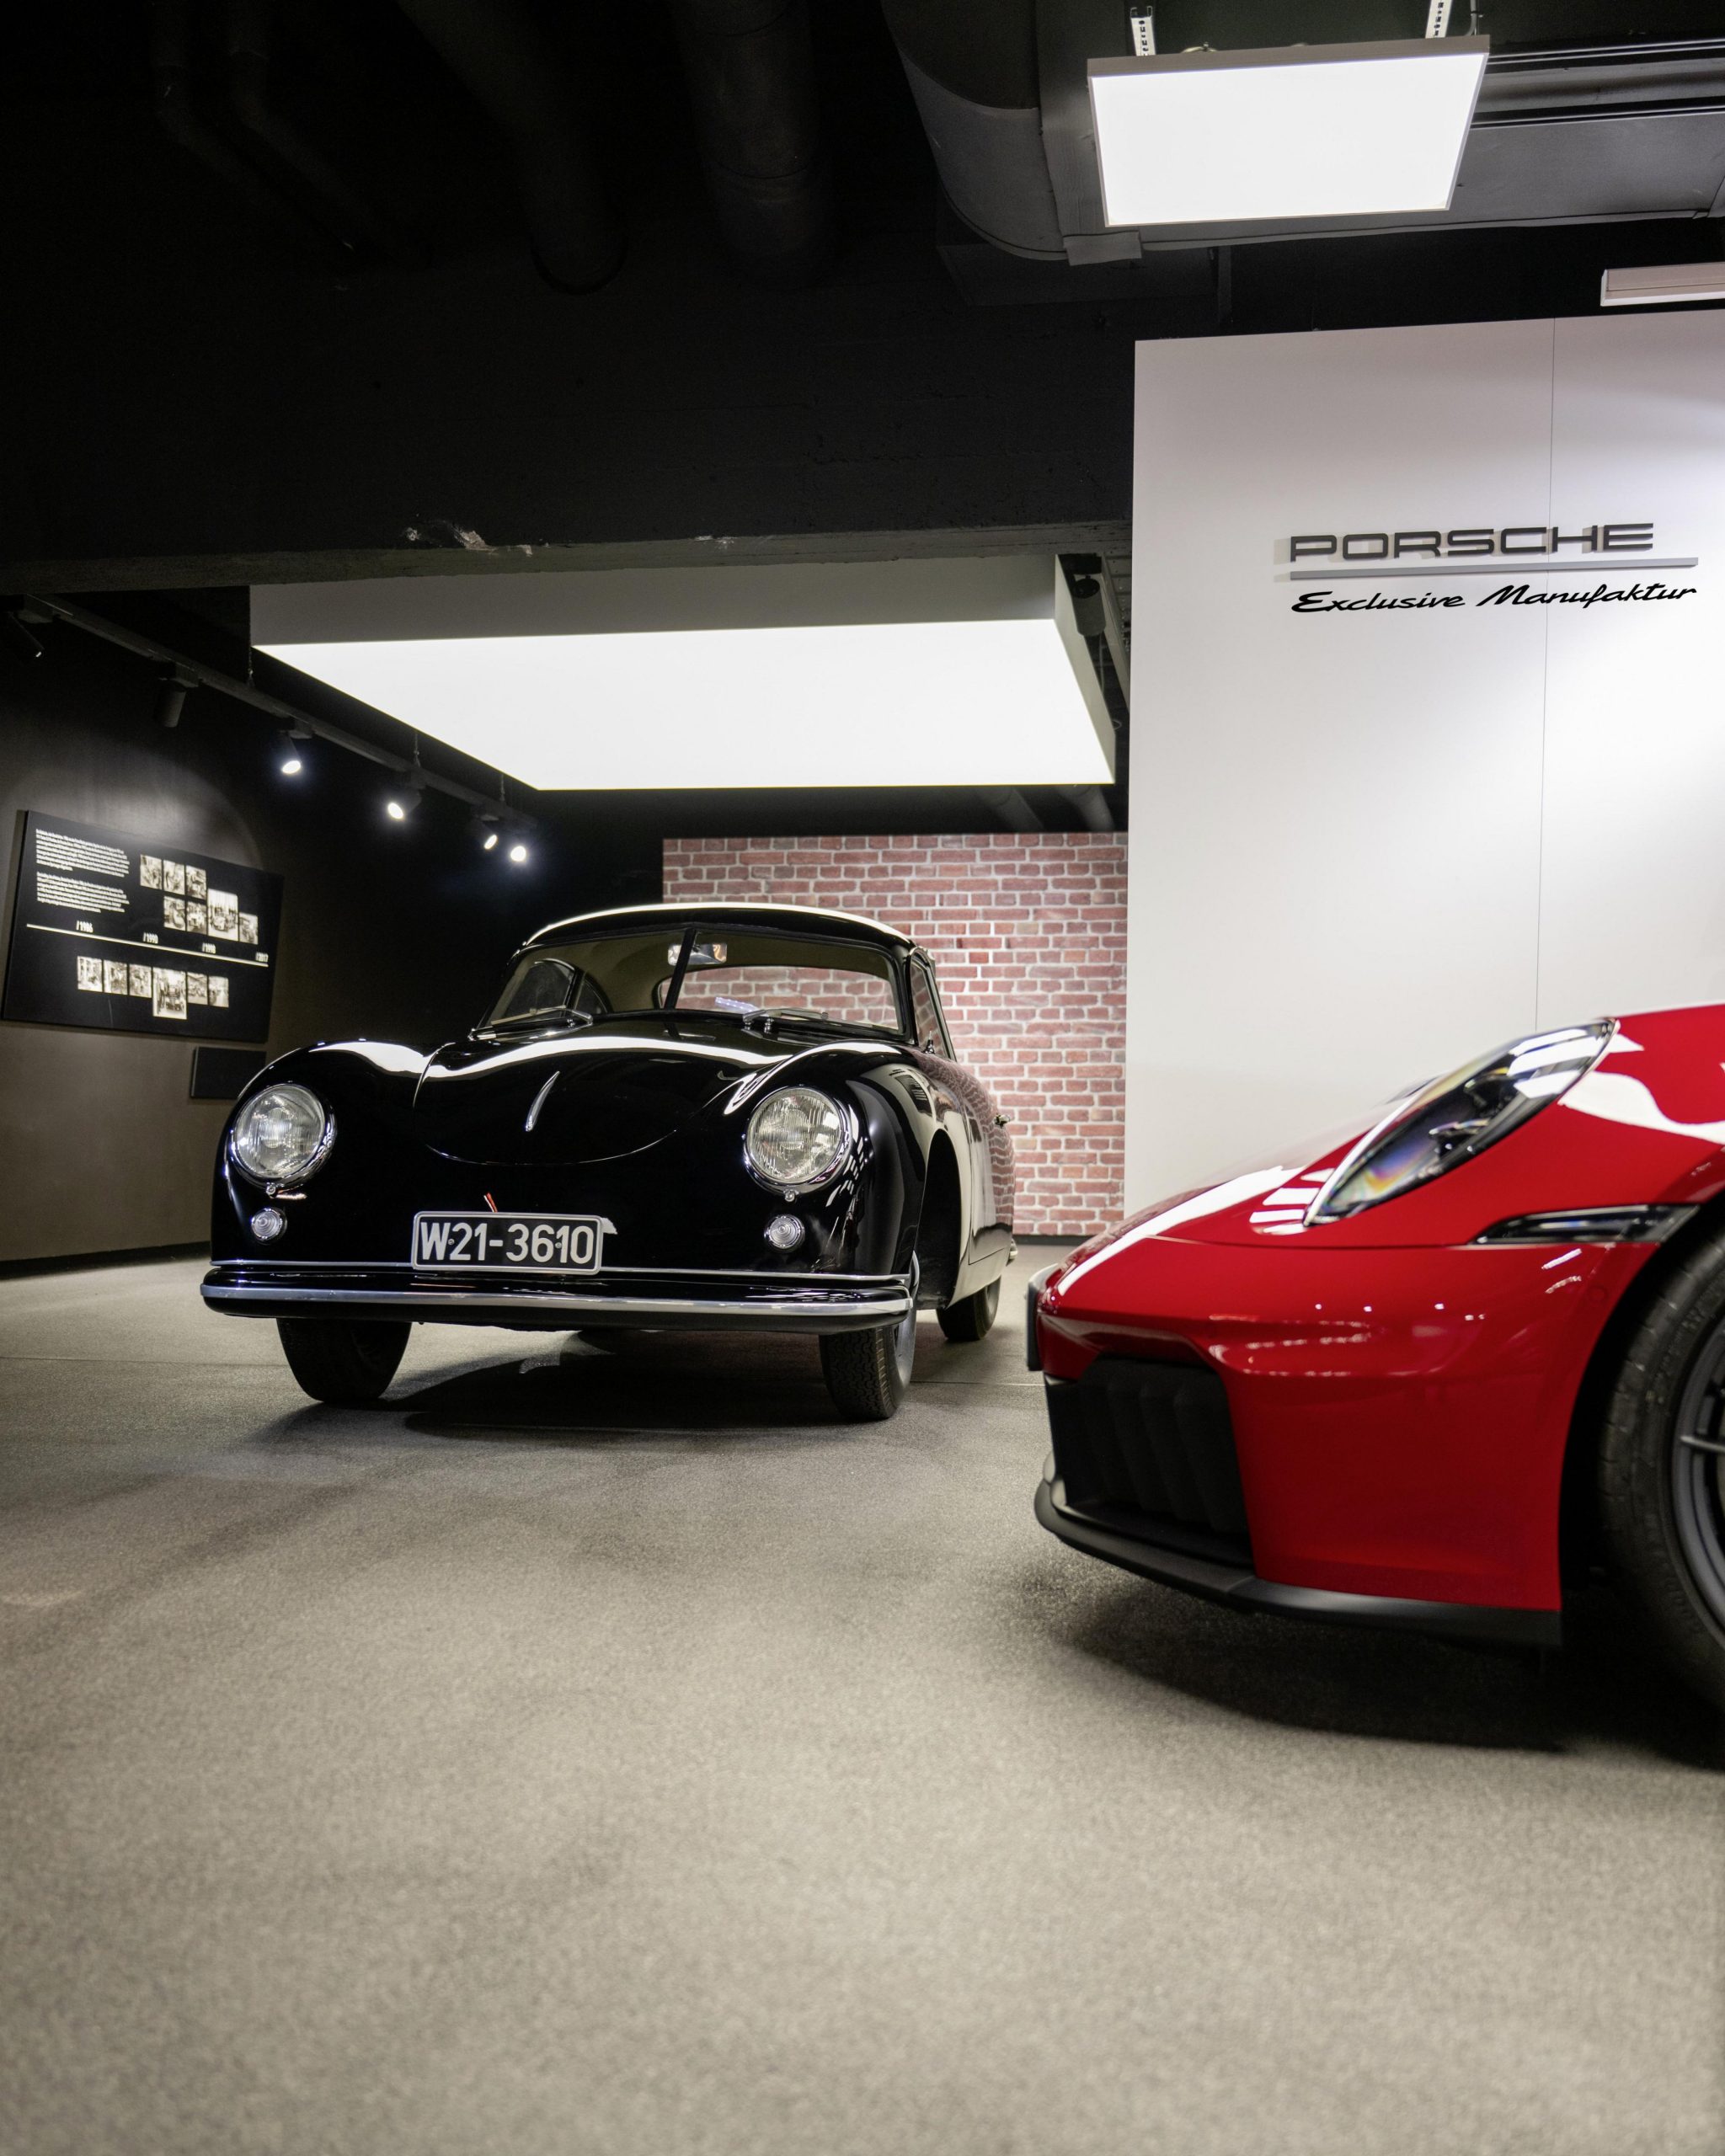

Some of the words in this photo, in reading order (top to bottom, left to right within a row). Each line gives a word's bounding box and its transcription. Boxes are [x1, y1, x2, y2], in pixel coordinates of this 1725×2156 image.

[1290, 523, 1653, 562] PORSCHE
[1291, 591, 1466, 613] Exclusive
[1476, 583, 1697, 609] Manufaktur
[420, 1221, 594, 1264] W21-3610
